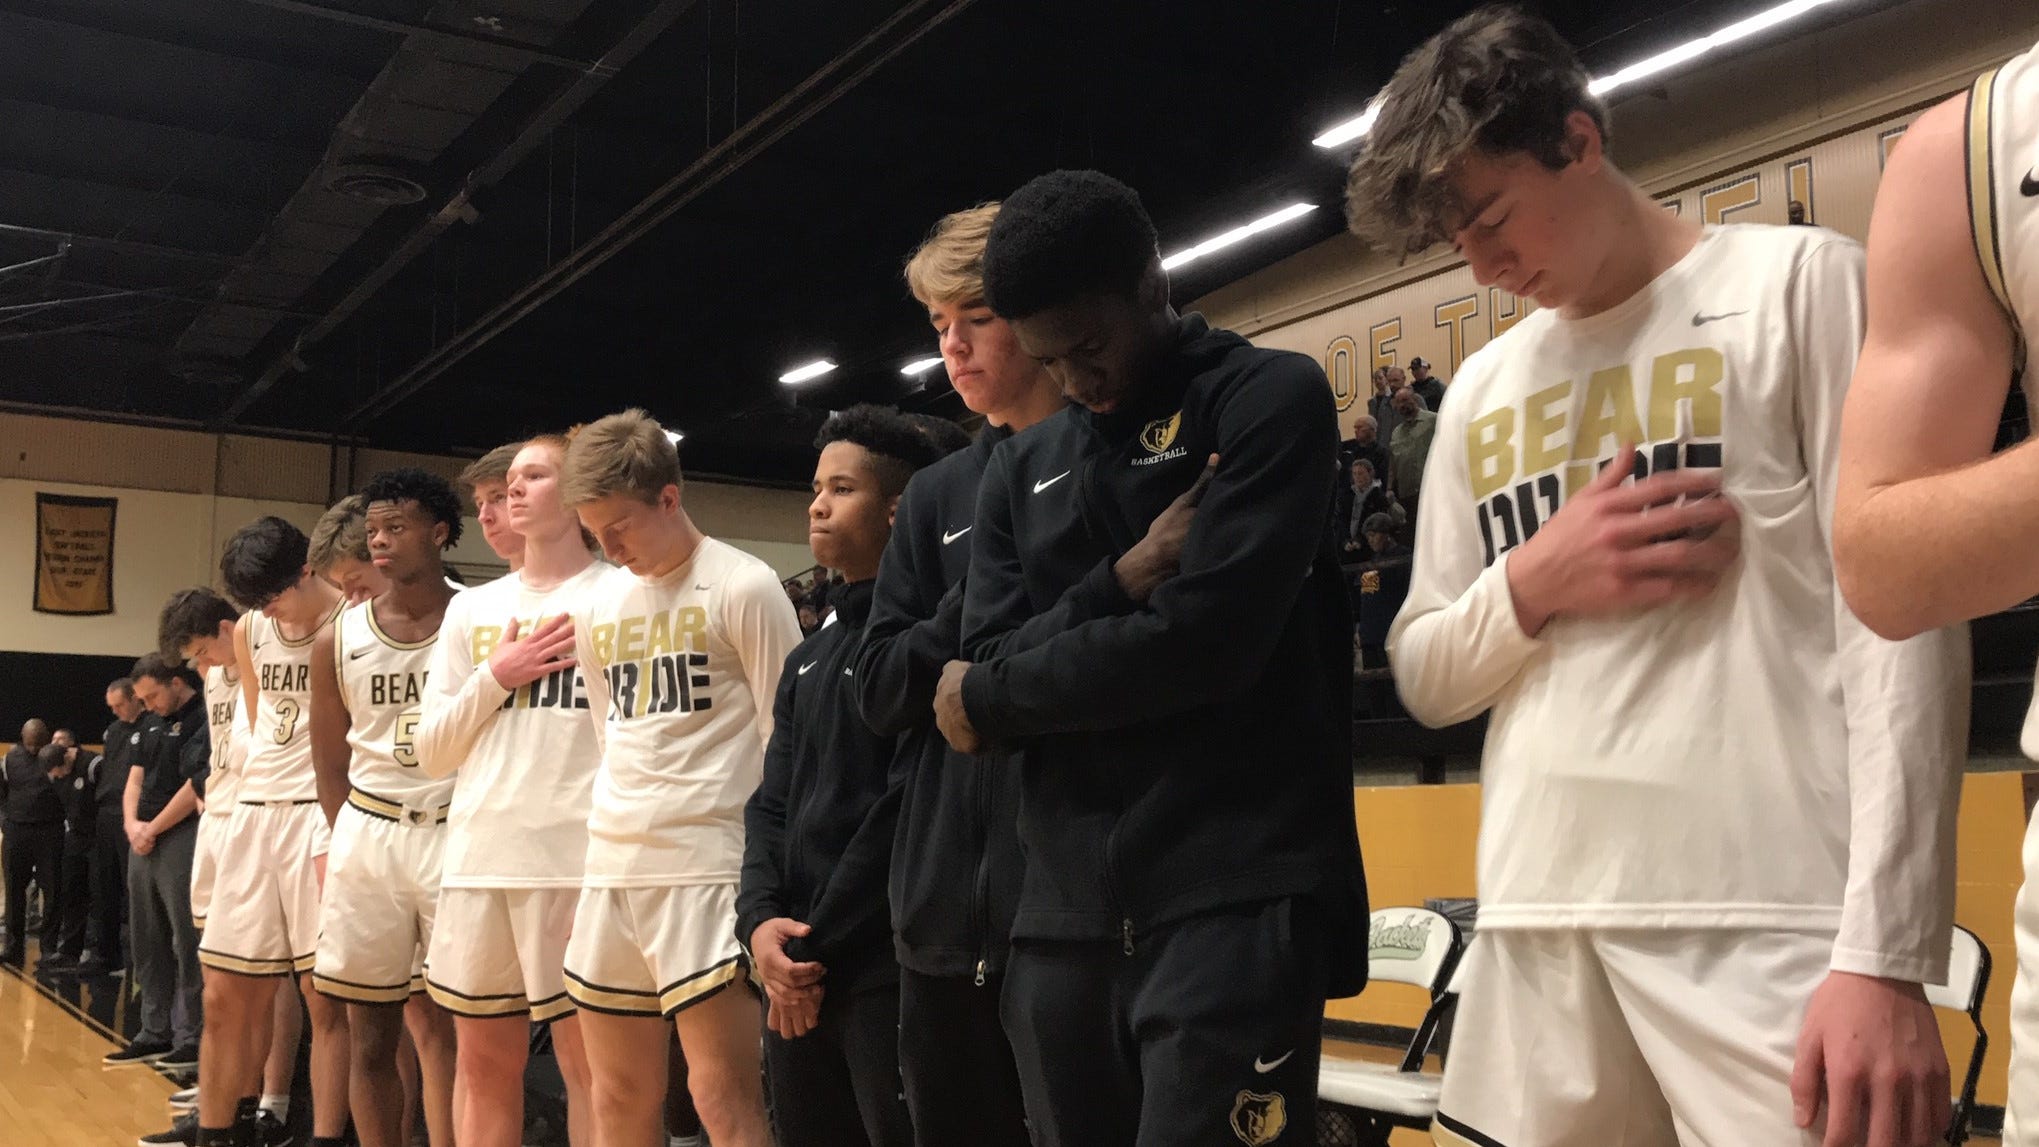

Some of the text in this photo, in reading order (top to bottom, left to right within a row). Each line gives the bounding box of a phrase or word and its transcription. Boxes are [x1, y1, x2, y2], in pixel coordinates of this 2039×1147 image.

[1325, 317, 1402, 412] OF
[1467, 347, 1724, 501] BEAR
[1131, 447, 1187, 466] BASKETBALL
[592, 607, 708, 667] BEAR
[212, 701, 236, 726] BEA
[603, 654, 712, 720] RIDE
[273, 698, 300, 746] 3
[393, 713, 422, 768] 5
